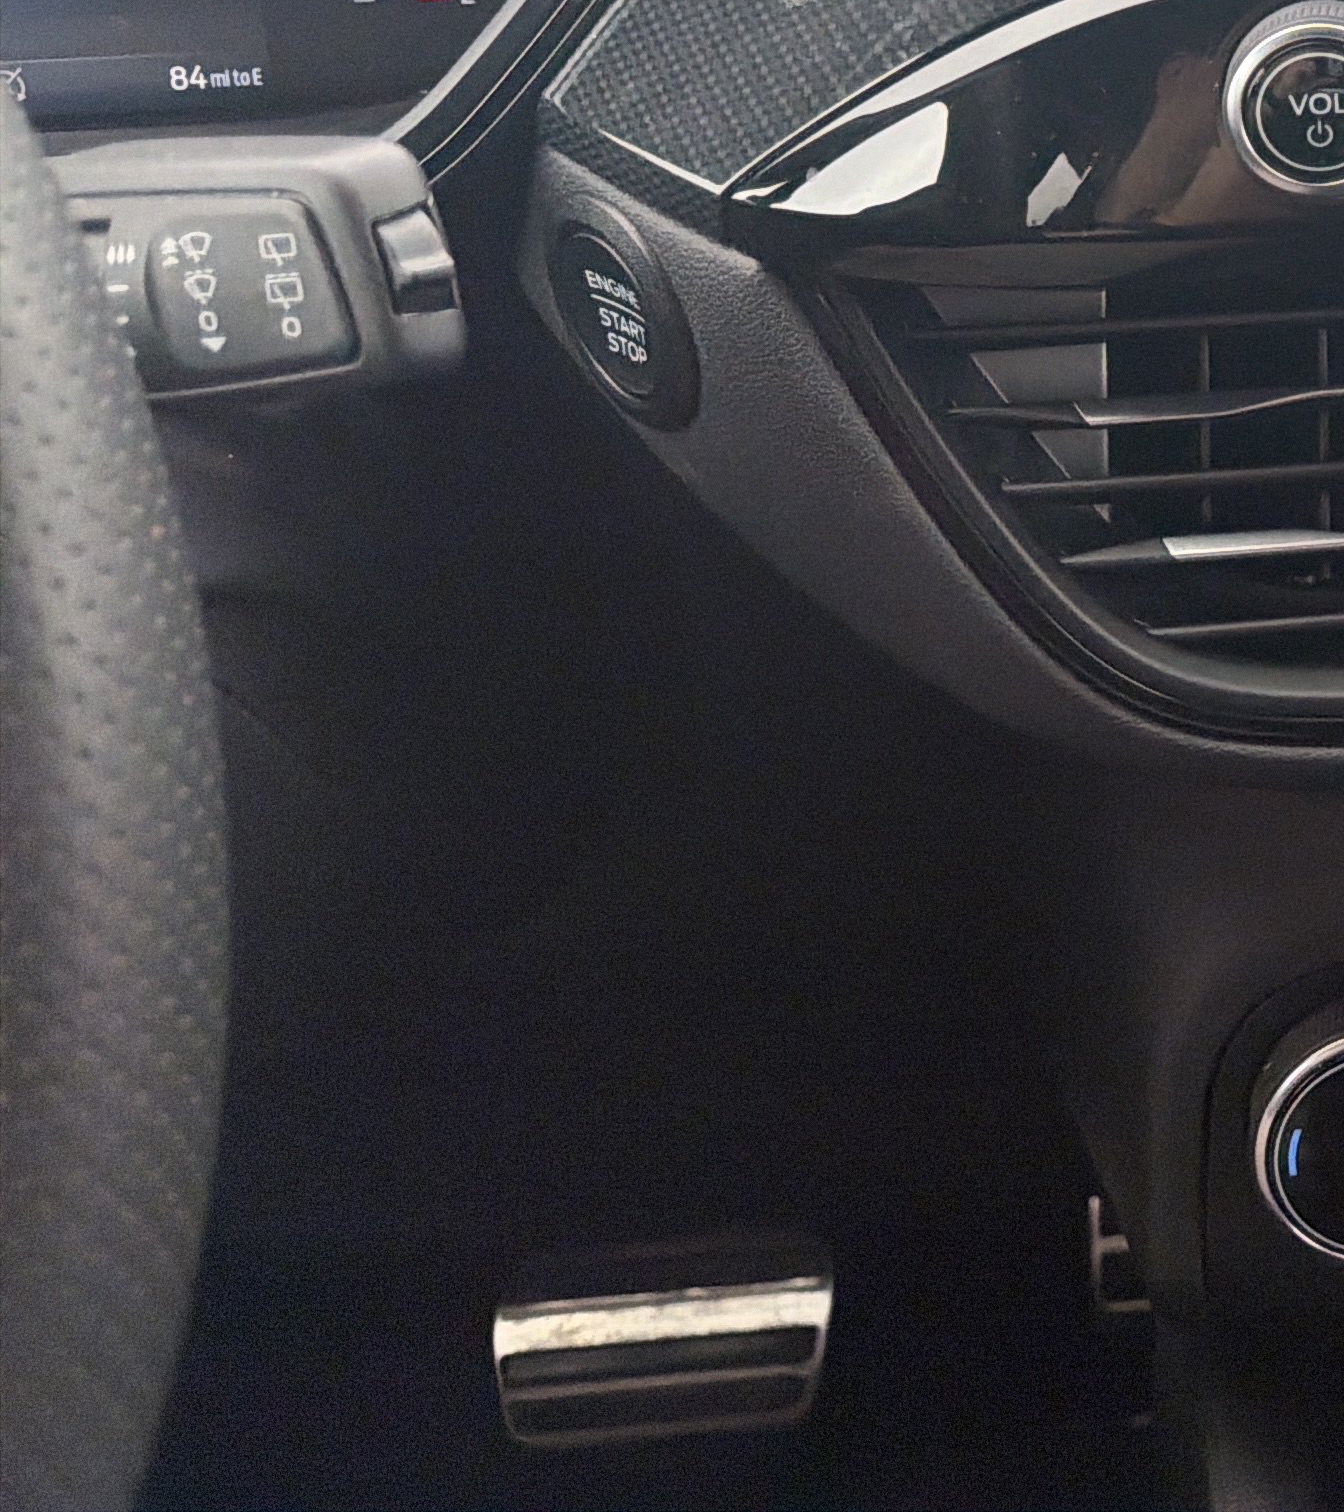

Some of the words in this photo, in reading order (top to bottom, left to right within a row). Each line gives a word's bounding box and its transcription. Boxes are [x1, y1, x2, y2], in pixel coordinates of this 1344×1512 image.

[169, 64, 209, 91] 84
[232, 68, 251, 87] to
[252, 67, 264, 86] E
[585, 269, 641, 311] ENGINE
[599, 307, 646, 346] START
[607, 331, 648, 365] STOP
